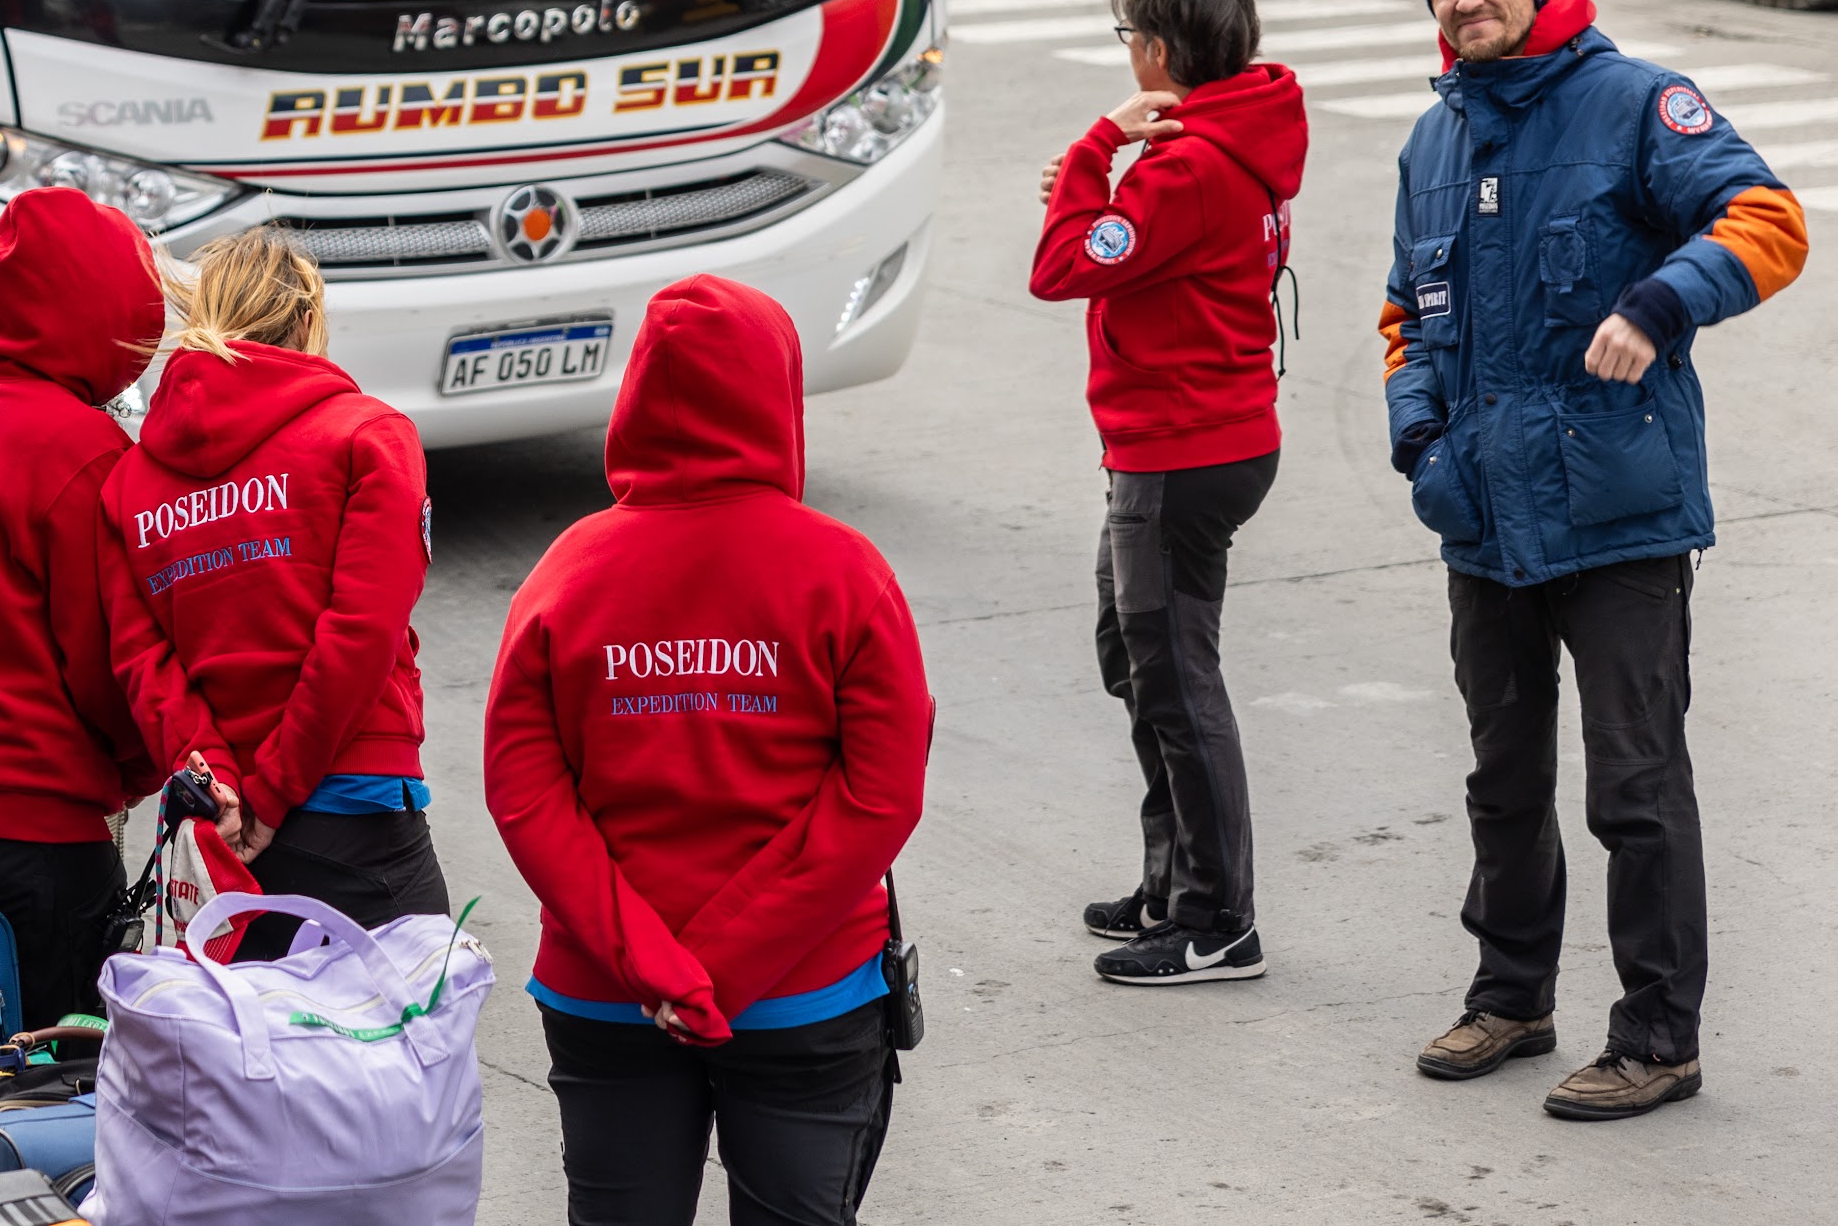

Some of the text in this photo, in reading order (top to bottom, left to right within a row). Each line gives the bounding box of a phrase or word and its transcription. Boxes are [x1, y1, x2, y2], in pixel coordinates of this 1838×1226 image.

[58, 97, 214, 127] SCANIA
[260, 50, 782, 142] RUMBO SUR
[1424, 290, 1447, 308] SPIRIT
[450, 341, 600, 389] AF 050 LM
[134, 473, 290, 549] POSEIDON
[146, 536, 292, 596] EXPEDITION TEAM
[603, 639, 779, 680] POSEIDON
[612, 692, 778, 715] EXPEDITION TEAM
[170, 878, 200, 906] STATE
